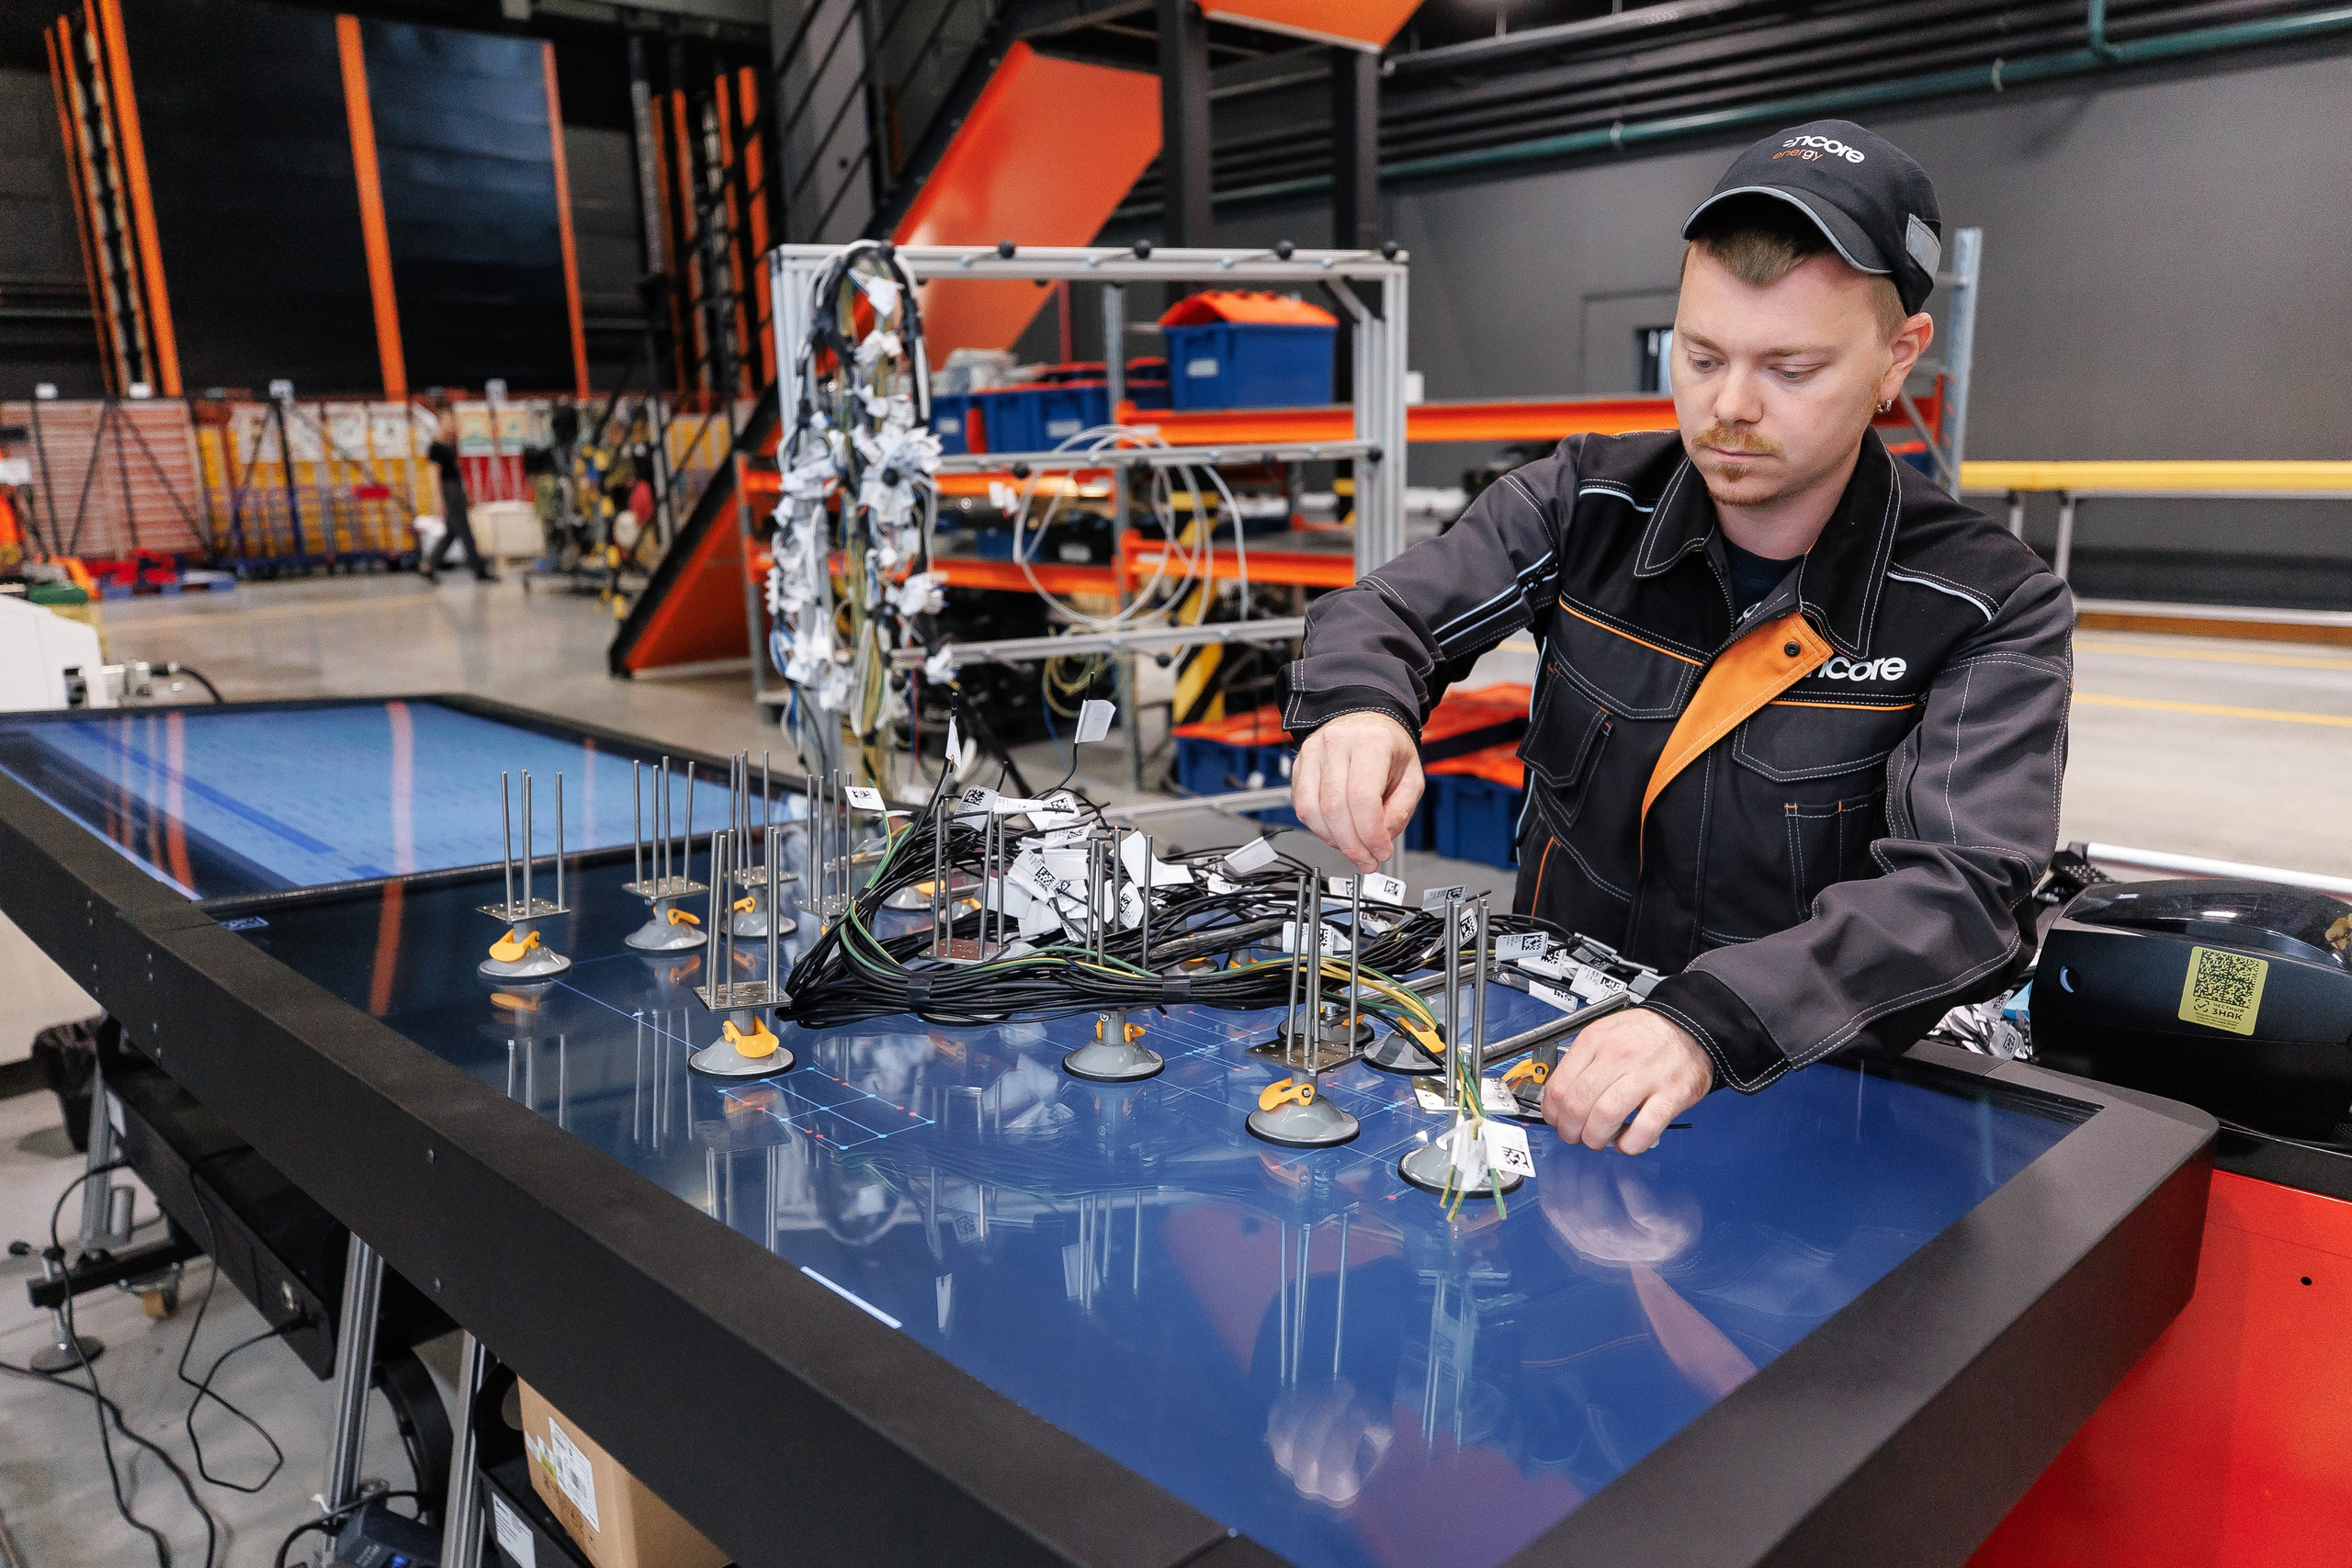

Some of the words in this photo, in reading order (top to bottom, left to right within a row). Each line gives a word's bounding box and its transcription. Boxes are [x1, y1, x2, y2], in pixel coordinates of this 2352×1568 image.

[1773, 149, 1824, 162] energy
[2213, 1002, 2245, 1013] ЧЕСТНЫЙ
[2211, 1008, 2243, 1021] ЗНАК
